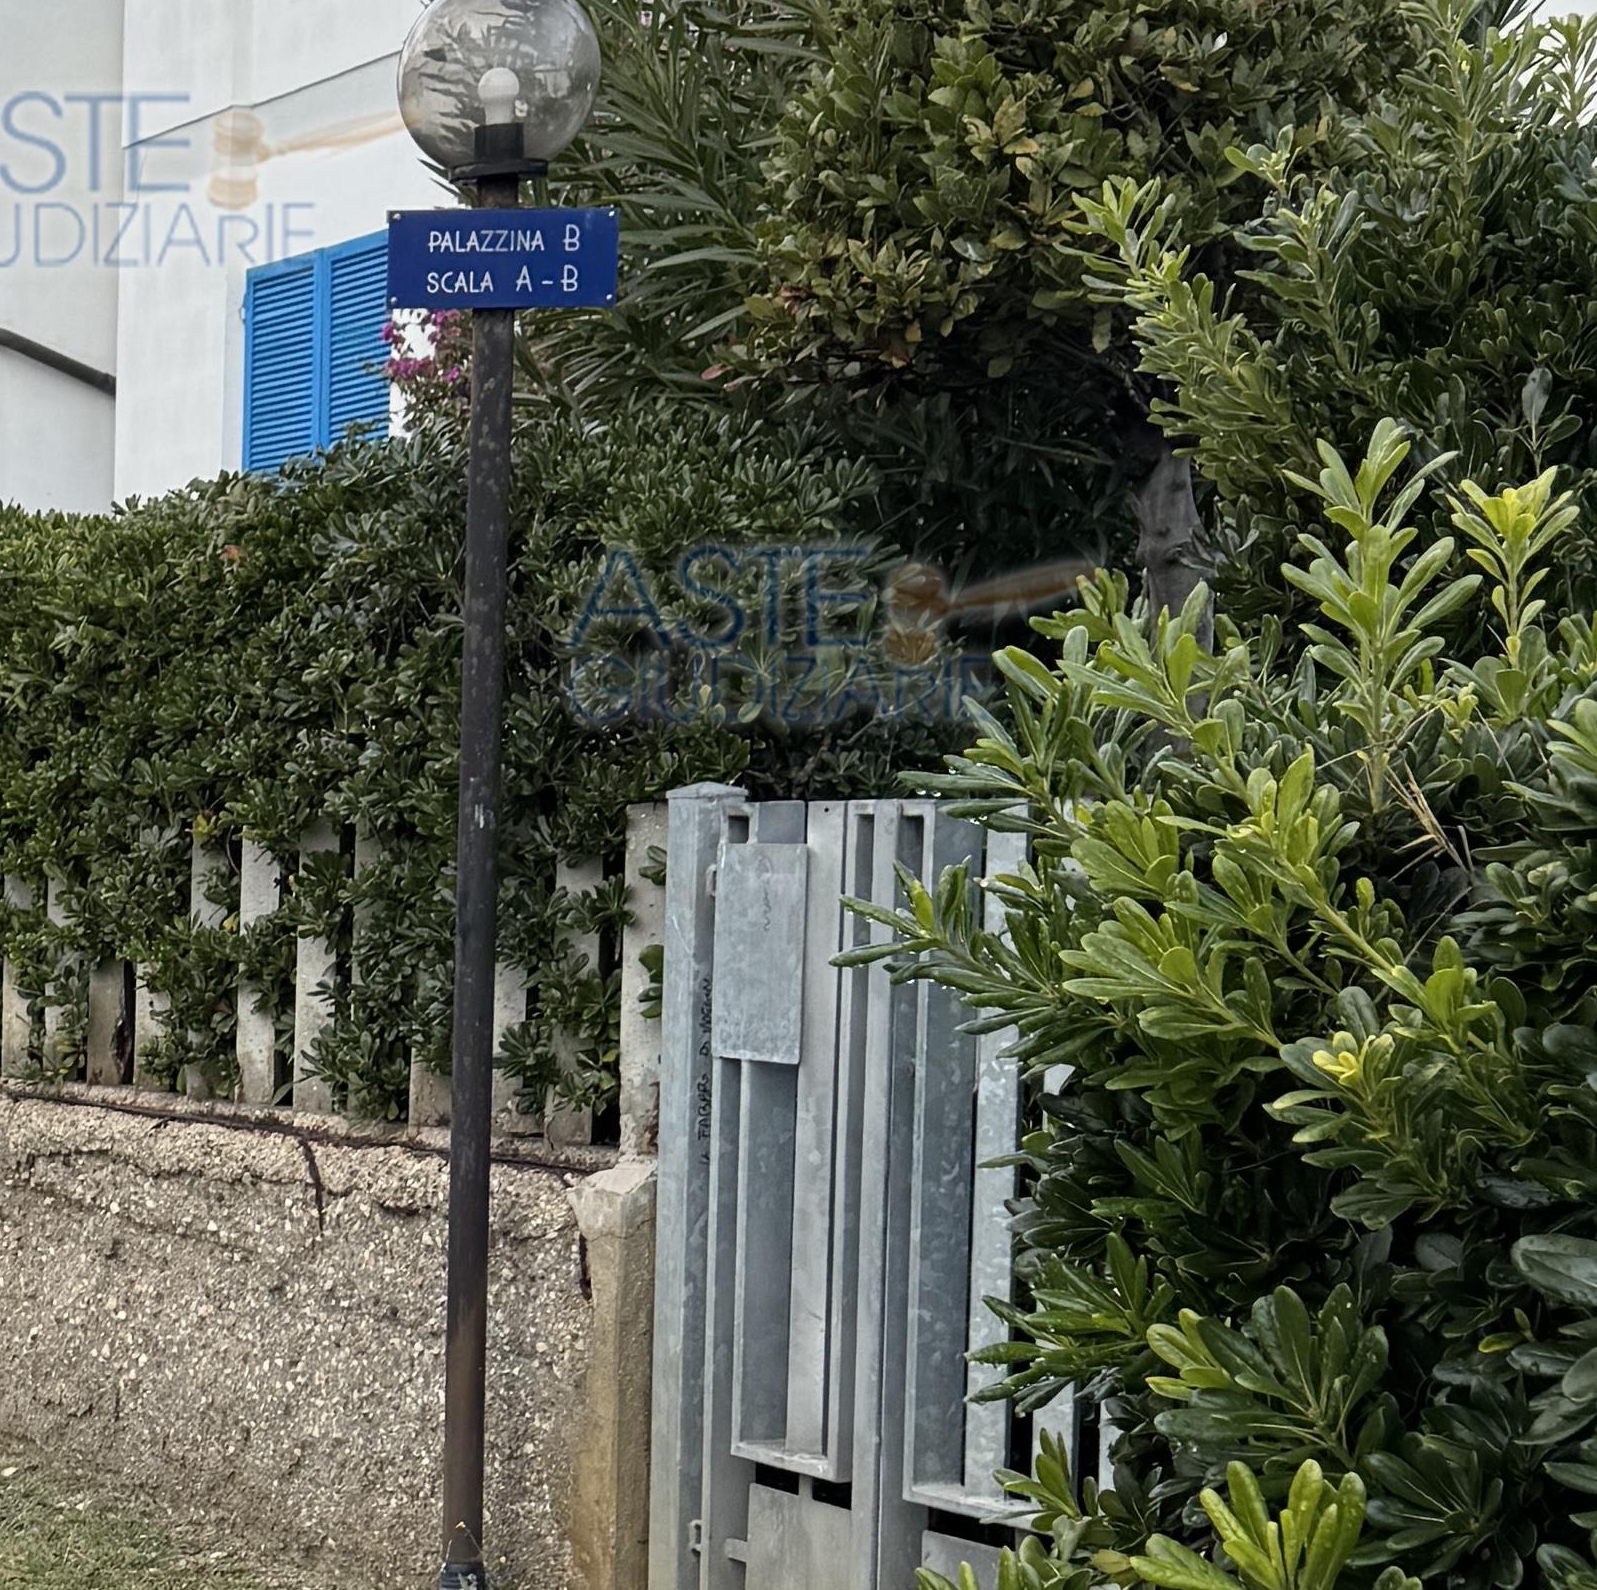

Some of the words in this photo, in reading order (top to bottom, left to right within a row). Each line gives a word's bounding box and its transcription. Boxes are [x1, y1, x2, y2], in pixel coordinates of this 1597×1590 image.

[428, 229, 545, 253] PALAZZINA
[562, 223, 580, 252] B
[426, 271, 494, 294] SCALA
